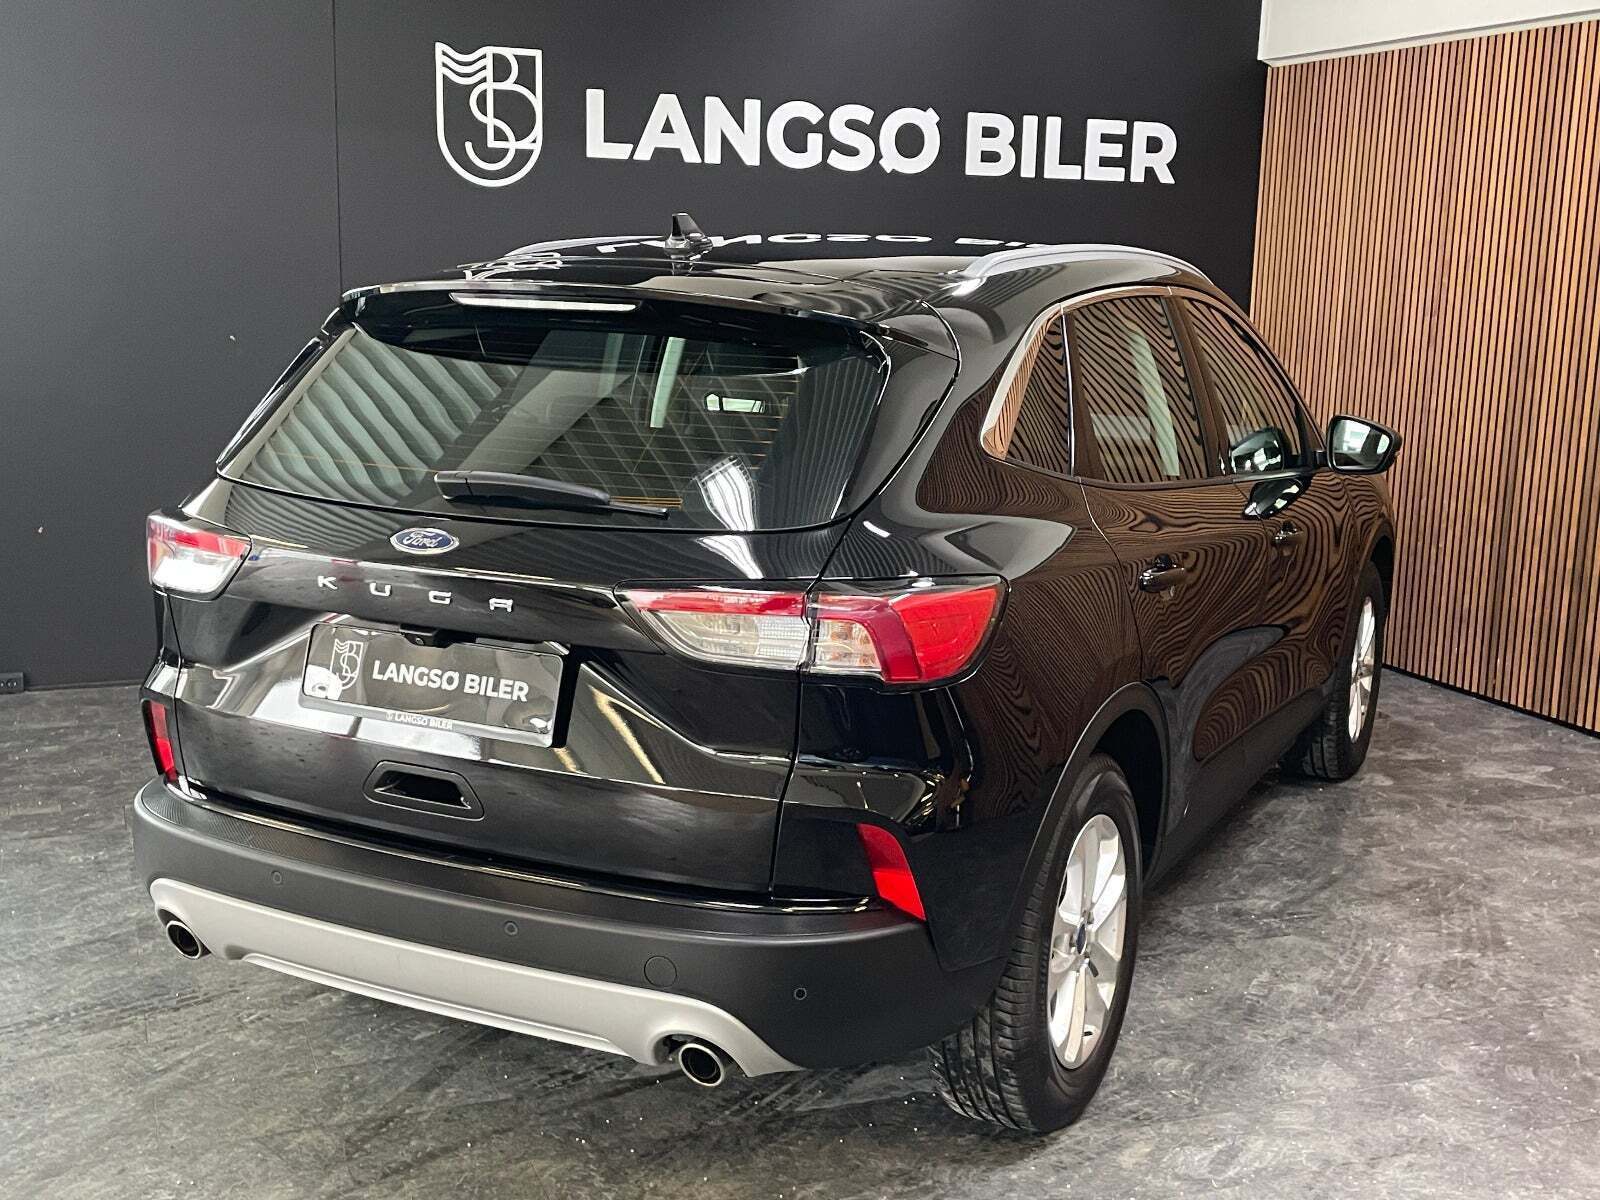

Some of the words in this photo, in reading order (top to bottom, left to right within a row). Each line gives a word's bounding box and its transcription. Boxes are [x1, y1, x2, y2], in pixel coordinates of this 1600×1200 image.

[585, 88, 941, 174] LANGSØ
[964, 111, 1177, 184] BILER
[402, 530, 443, 548] Ford
[317, 575, 513, 612] KUGA
[372, 660, 460, 691] LANGSØ
[463, 674, 529, 702] BILER
